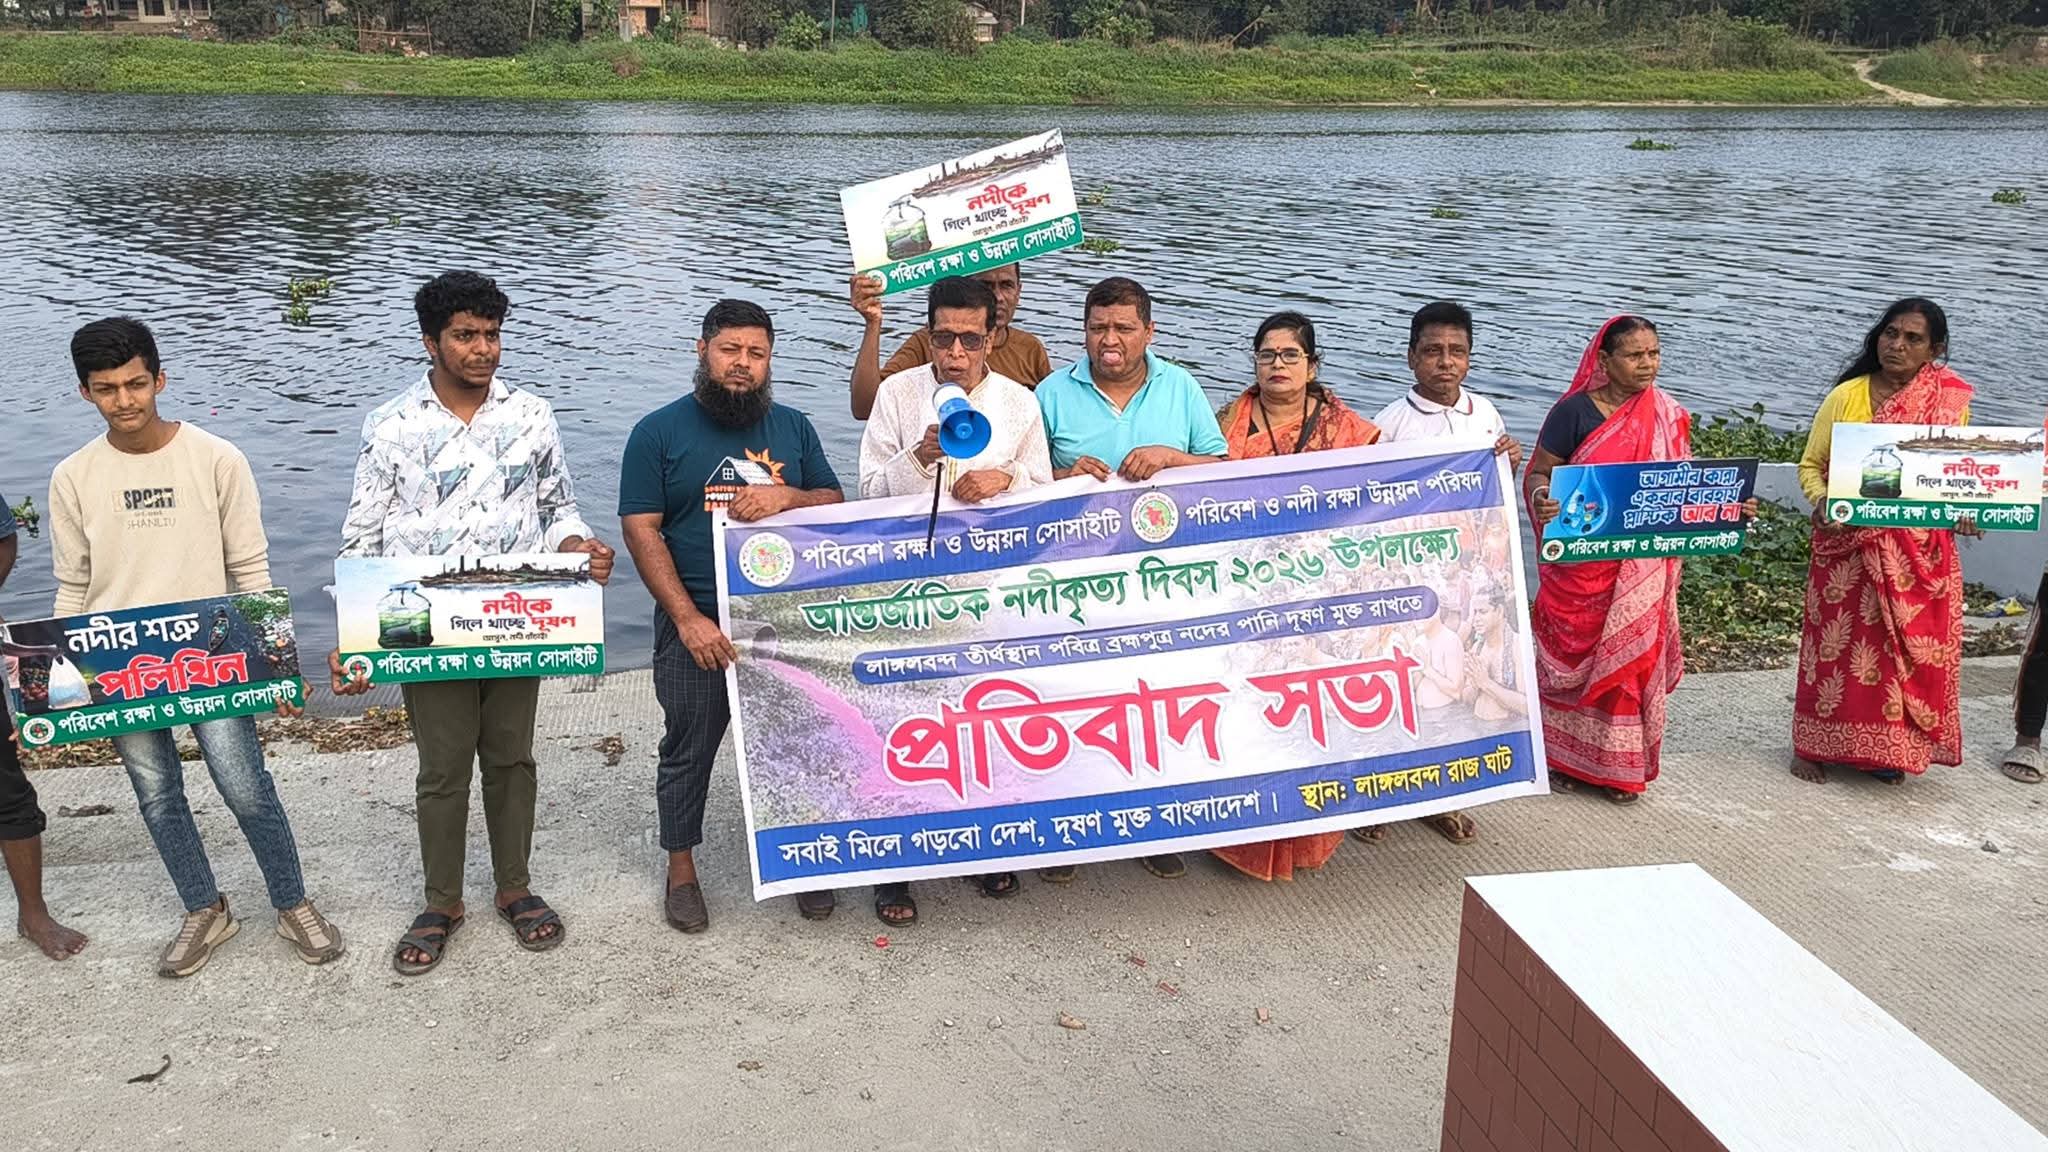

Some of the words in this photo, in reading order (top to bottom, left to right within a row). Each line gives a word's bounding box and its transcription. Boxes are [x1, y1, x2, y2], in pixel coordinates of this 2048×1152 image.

[943, 216, 971, 232] গিলে
[975, 205, 1008, 223] খাচ্ছে
[1011, 192, 1051, 217] দূষণ
[965, 182, 1028, 212] নদীকে
[889, 258, 936, 285] পরিবেশ
[939, 251, 966, 271] রক্ষা
[968, 249, 979, 264] ও
[981, 236, 1020, 260] উন্নয়ন
[1022, 217, 1077, 249] সোসাইটি
[1639, 462, 1702, 488] আগামীর
[1703, 467, 1739, 486] কান্না
[1916, 475, 1942, 488] গিলে
[1945, 477, 1977, 489] খাচ্ছে
[1980, 478, 2019, 493] দূষণ
[1943, 457, 2001, 478] নদীকে
[124, 488, 174, 509] SPORT
[1185, 497, 1257, 526] পরিবেশ
[1263, 498, 1281, 516] ও
[1284, 485, 1318, 514] নদী
[1323, 485, 1361, 509] রক্ষা
[1366, 479, 1421, 506] উন্নয়ন
[1426, 469, 1483, 494] পরিষদ
[1631, 488, 1687, 506] একবার
[1681, 504, 1719, 524] আর
[1720, 503, 1742, 522] না
[1856, 504, 1899, 521] পরিবেশ
[1902, 505, 1928, 520] রক্ষা
[1931, 508, 1941, 520] ও
[1982, 505, 2035, 525] সোসাইটি
[888, 536, 936, 562] রক্ষা
[944, 536, 962, 554] ও
[968, 526, 1029, 554] উন্নয়ন
[1036, 508, 1122, 545] সোসাইটি
[1567, 538, 1609, 556] পরিবেশ
[1612, 539, 1635, 553] রক্ষা
[1639, 539, 1649, 551] ও
[1652, 535, 1685, 553] উন্নয়ন
[1689, 530, 1739, 551] সোসাইটি
[482, 592, 553, 617] নদীকে
[799, 581, 990, 636] আন্তর্জাতিক
[998, 568, 1129, 625] নদীকৃত্য
[1136, 556, 1218, 600] দিবস
[1231, 550, 1324, 591] ২০২৬
[64, 615, 138, 652] নদীর
[142, 612, 200, 643] শত্রু
[450, 616, 483, 631] গিলে
[487, 616, 526, 632] খাচ্ছে
[530, 615, 576, 633] দূষণ
[963, 642, 1041, 666] তীর্থস্থান
[1048, 634, 1101, 658] পবিত্র
[1176, 621, 1231, 642] নদের
[1237, 609, 1280, 633] পানি
[1284, 604, 1326, 633] দূষণ
[1330, 603, 1363, 626] মুক্ত
[1369, 595, 1423, 618] রাখতে
[95, 648, 249, 700] পলিথিন
[376, 653, 433, 676] পরিবেশ
[437, 655, 468, 672] রক্ষা
[472, 655, 485, 669] ও
[490, 648, 532, 671] উন্নয়ন
[537, 643, 599, 670] সোসাইটি
[58, 709, 119, 735] পরিবেশ
[123, 704, 156, 723] রক্ষা
[161, 705, 175, 717] ও
[179, 695, 227, 716] উন্নয়ন
[231, 680, 298, 708] সোসাইটি
[886, 678, 1231, 800] প্রতিবাদ
[1247, 646, 1421, 748] সভা
[1352, 764, 1442, 799] লাঙ্গলবন্দ
[1445, 755, 1480, 783] রাজ
[1483, 744, 1513, 774] ঘাট
[779, 833, 843, 865] সবাই
[848, 830, 903, 861] মিলে
[910, 823, 981, 857] গড়বো
[990, 817, 1045, 847] দেশ,
[1051, 810, 1103, 846] দূষণ
[1108, 805, 1152, 838] মুক্ত
[1157, 790, 1261, 827] বাংলাদেশ
